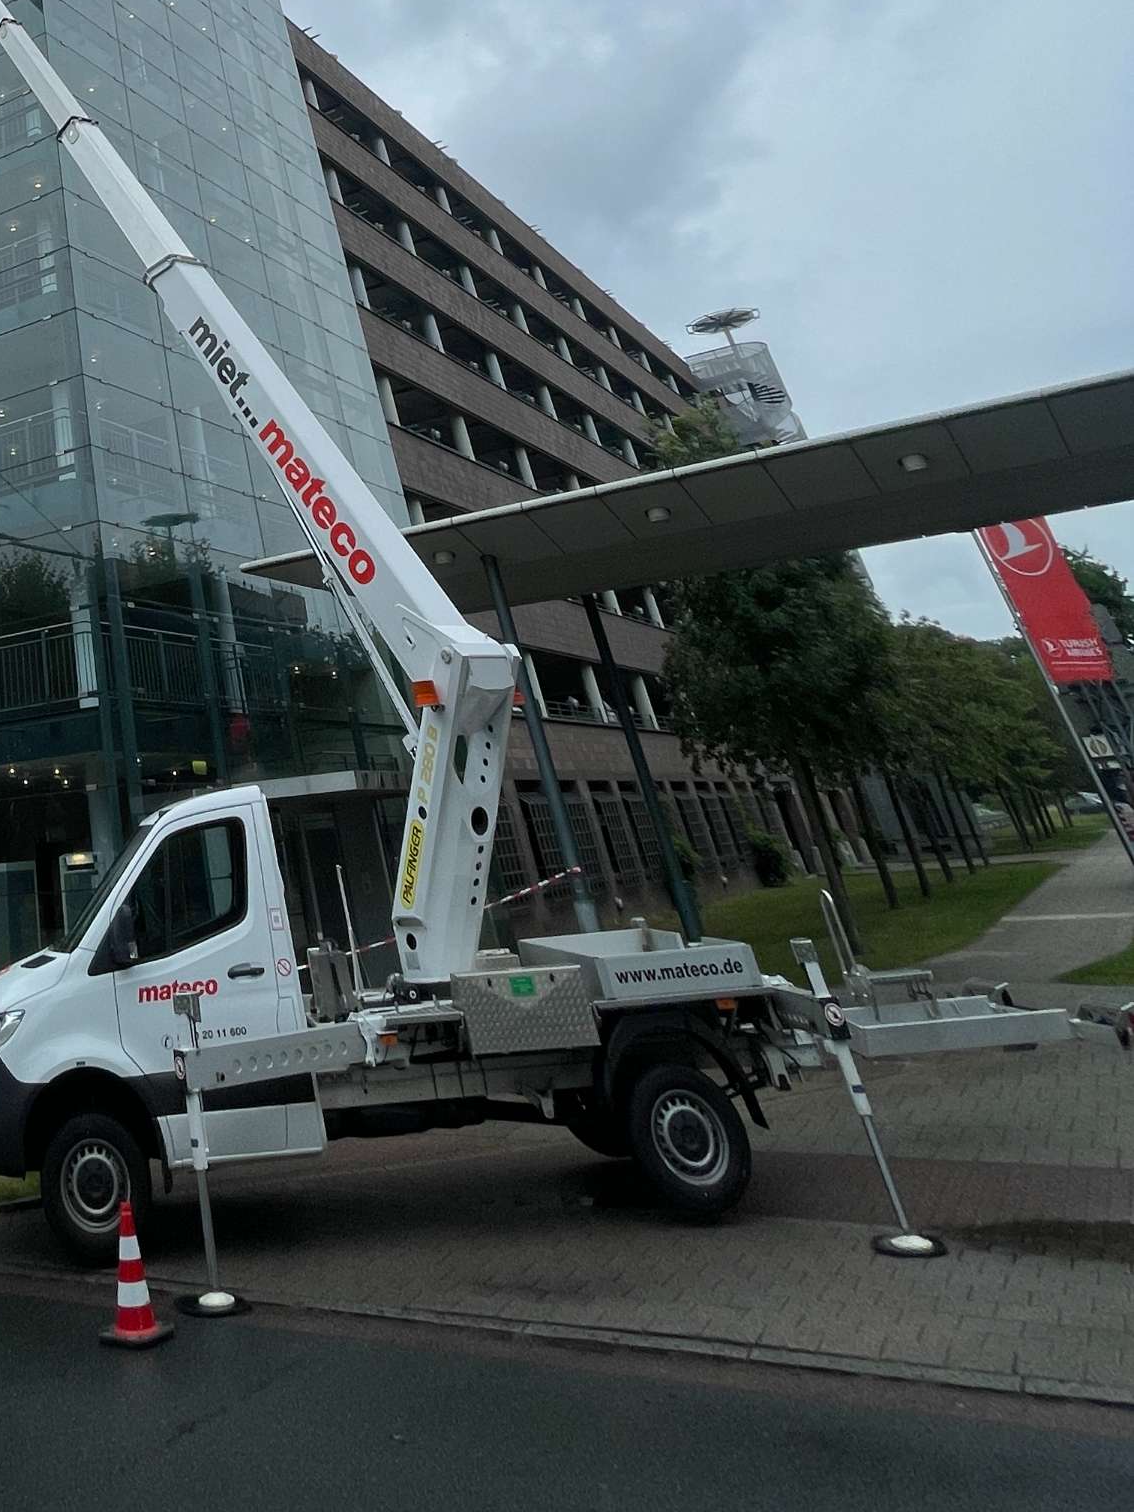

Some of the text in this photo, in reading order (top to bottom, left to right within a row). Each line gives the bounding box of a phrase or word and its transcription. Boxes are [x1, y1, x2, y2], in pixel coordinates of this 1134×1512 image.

[188, 316, 259, 428] miet...
[259, 419, 376, 585] mateco
[403, 825, 422, 904] PALFINGER
[615, 958, 743, 984] www.mateco.de
[202, 1030, 213, 1039] 20
[217, 1029, 226, 1038] 11
[230, 1027, 247, 1037] 600
